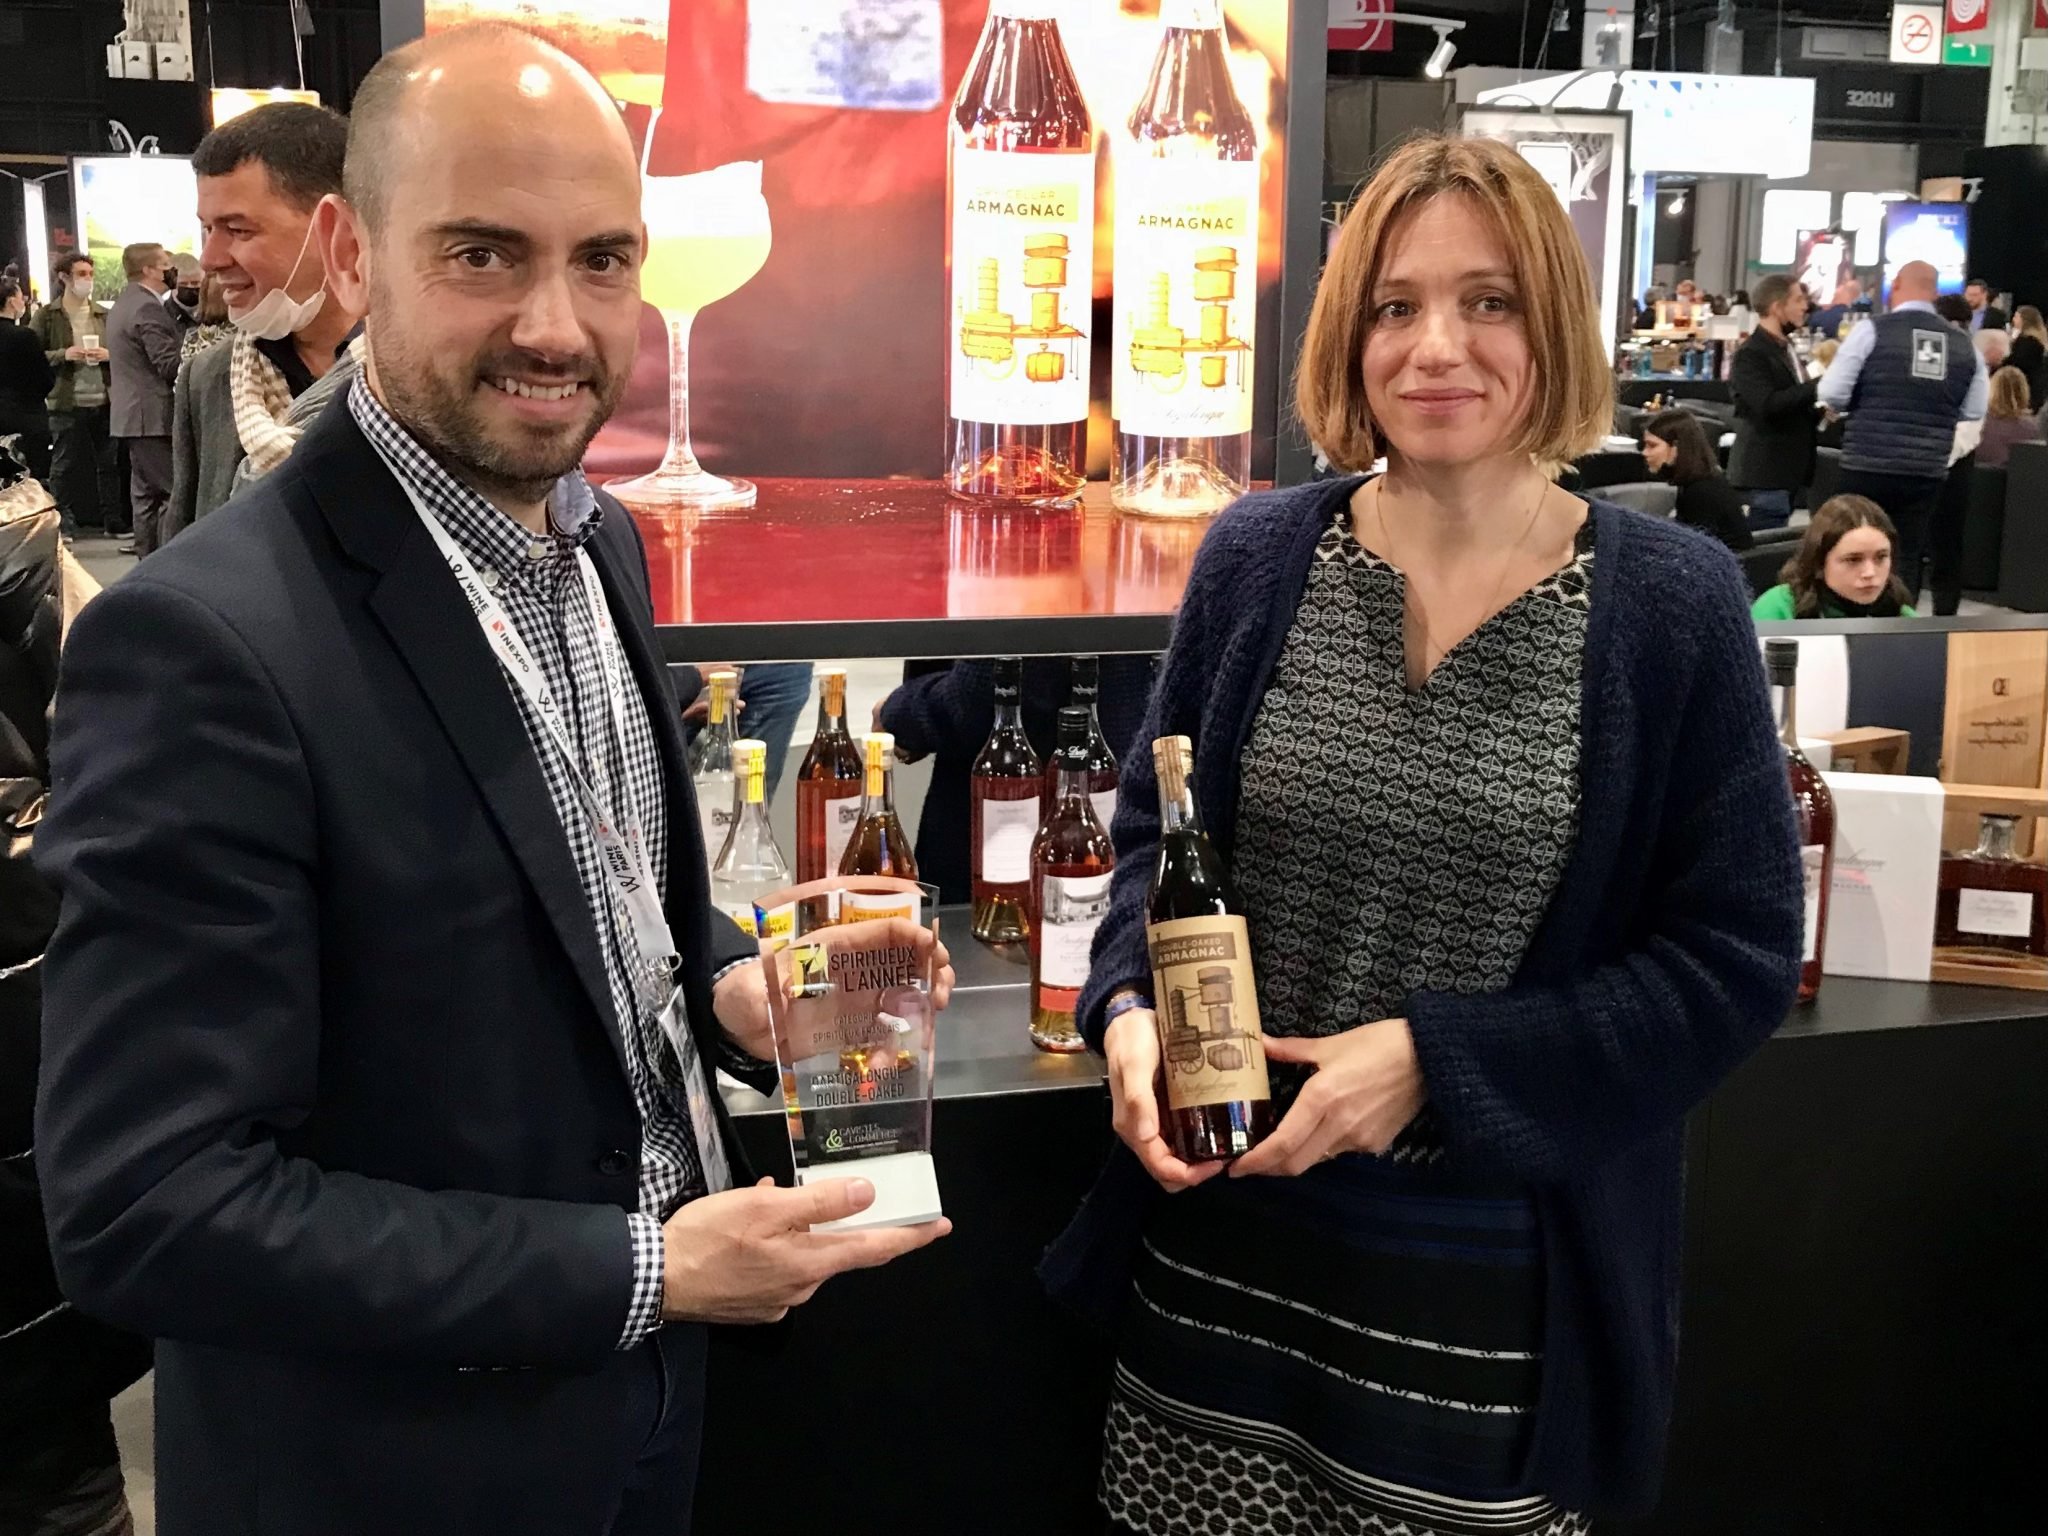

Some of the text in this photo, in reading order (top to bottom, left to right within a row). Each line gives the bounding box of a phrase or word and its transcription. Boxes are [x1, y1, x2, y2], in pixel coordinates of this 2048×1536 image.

[966, 198, 1066, 218] ARMAGNAC
[1138, 214, 1235, 231] ARMAGNAC
[605, 845, 621, 873] WINE
[613, 844, 631, 871] PARIS
[830, 945, 916, 971] SPIRITUEUX
[1158, 946, 1226, 964] ARMAGNAC
[816, 1083, 905, 1107] DOUBLE-OAKED
